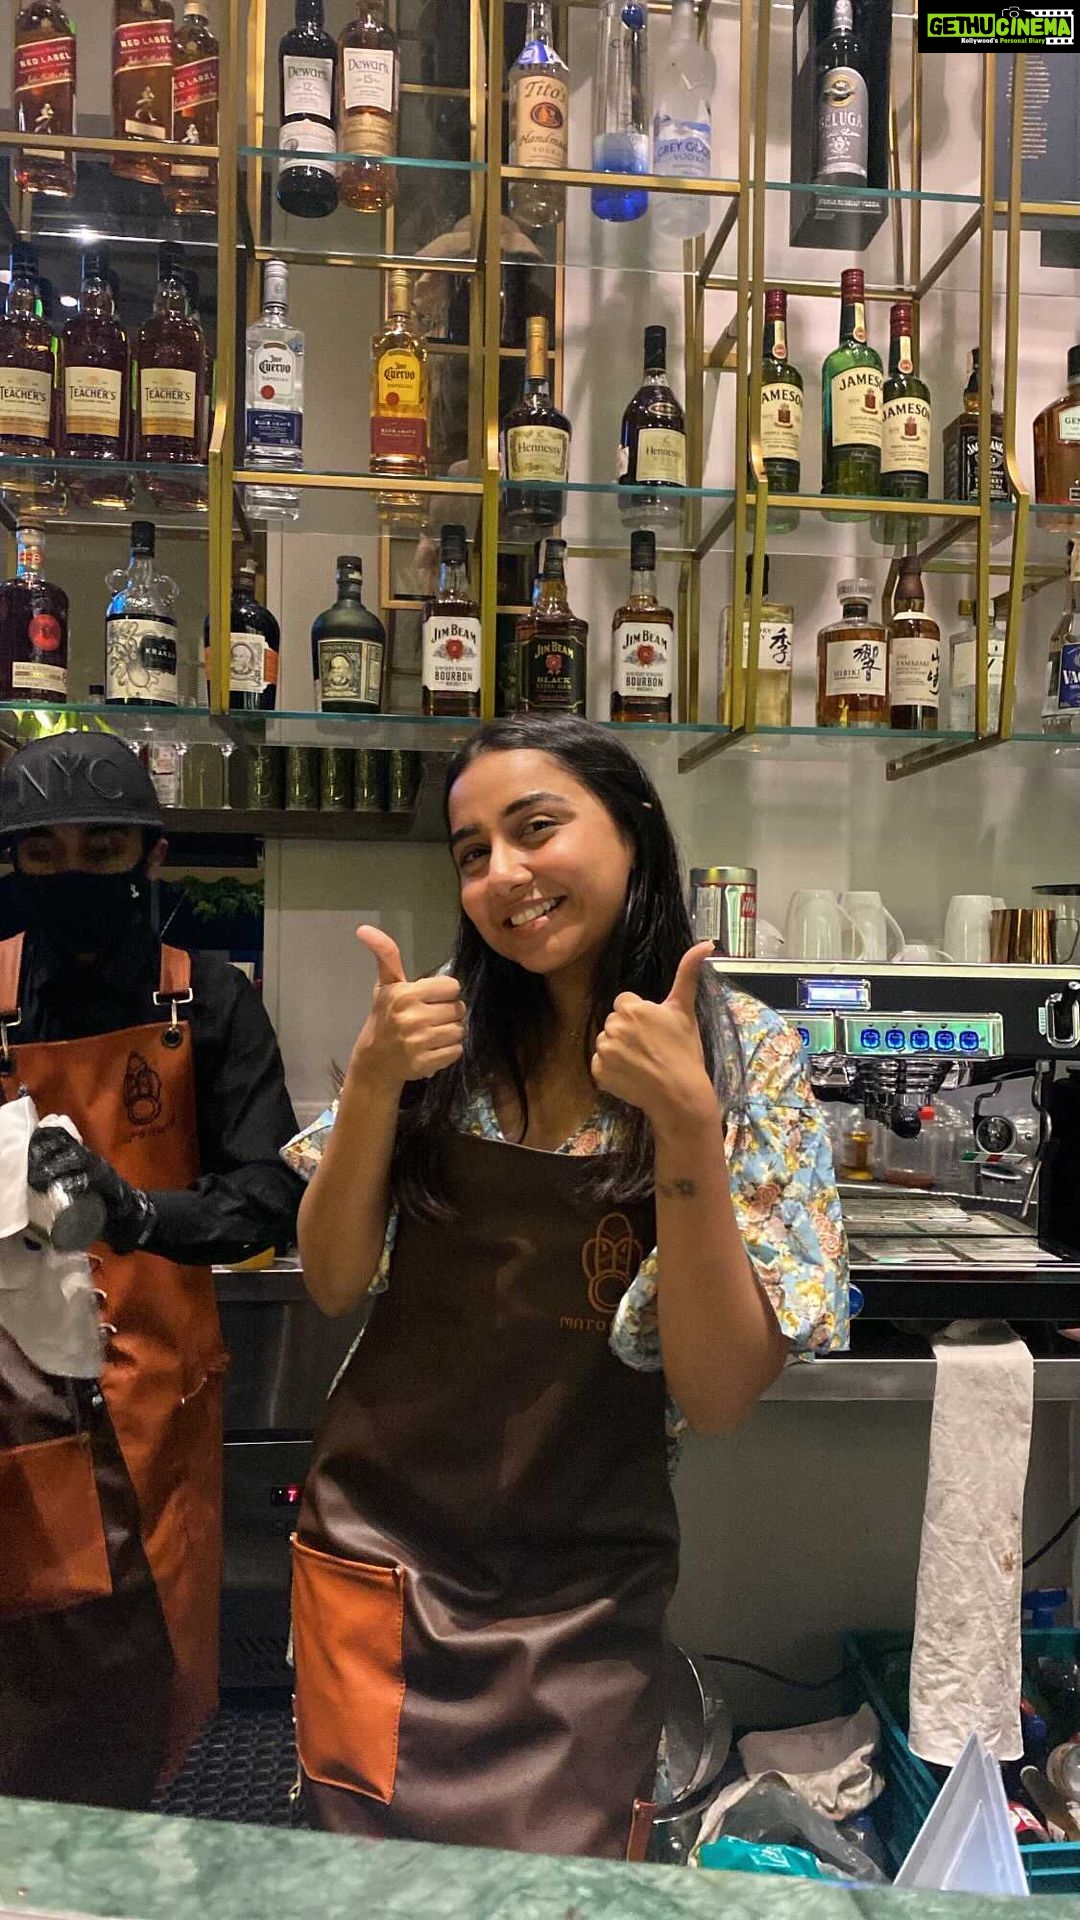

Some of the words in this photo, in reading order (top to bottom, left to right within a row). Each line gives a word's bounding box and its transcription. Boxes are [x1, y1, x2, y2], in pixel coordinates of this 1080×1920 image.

[119, 38, 140, 48] RED
[141, 35, 172, 46] LABEL
[19, 57, 40, 68] RED
[40, 51, 72, 64] LABEL
[258, 359, 291, 374] Cuervo
[384, 366, 415, 381] Cuervo
[69, 386, 117, 401] TEACHER'S
[145, 387, 192, 402] TEACHER'S
[761, 389, 801, 405] AMESO
[431, 627, 450, 643] JIM
[451, 624, 476, 644] BEAM
[622, 633, 641, 650] JIM
[642, 630, 667, 650] BEAM
[534, 644, 550, 659] JIM
[551, 641, 574, 659] BEAM
[434, 670, 473, 681] BOURBON
[625, 676, 664, 687] BOURBON
[17, 751, 125, 803] NYC
